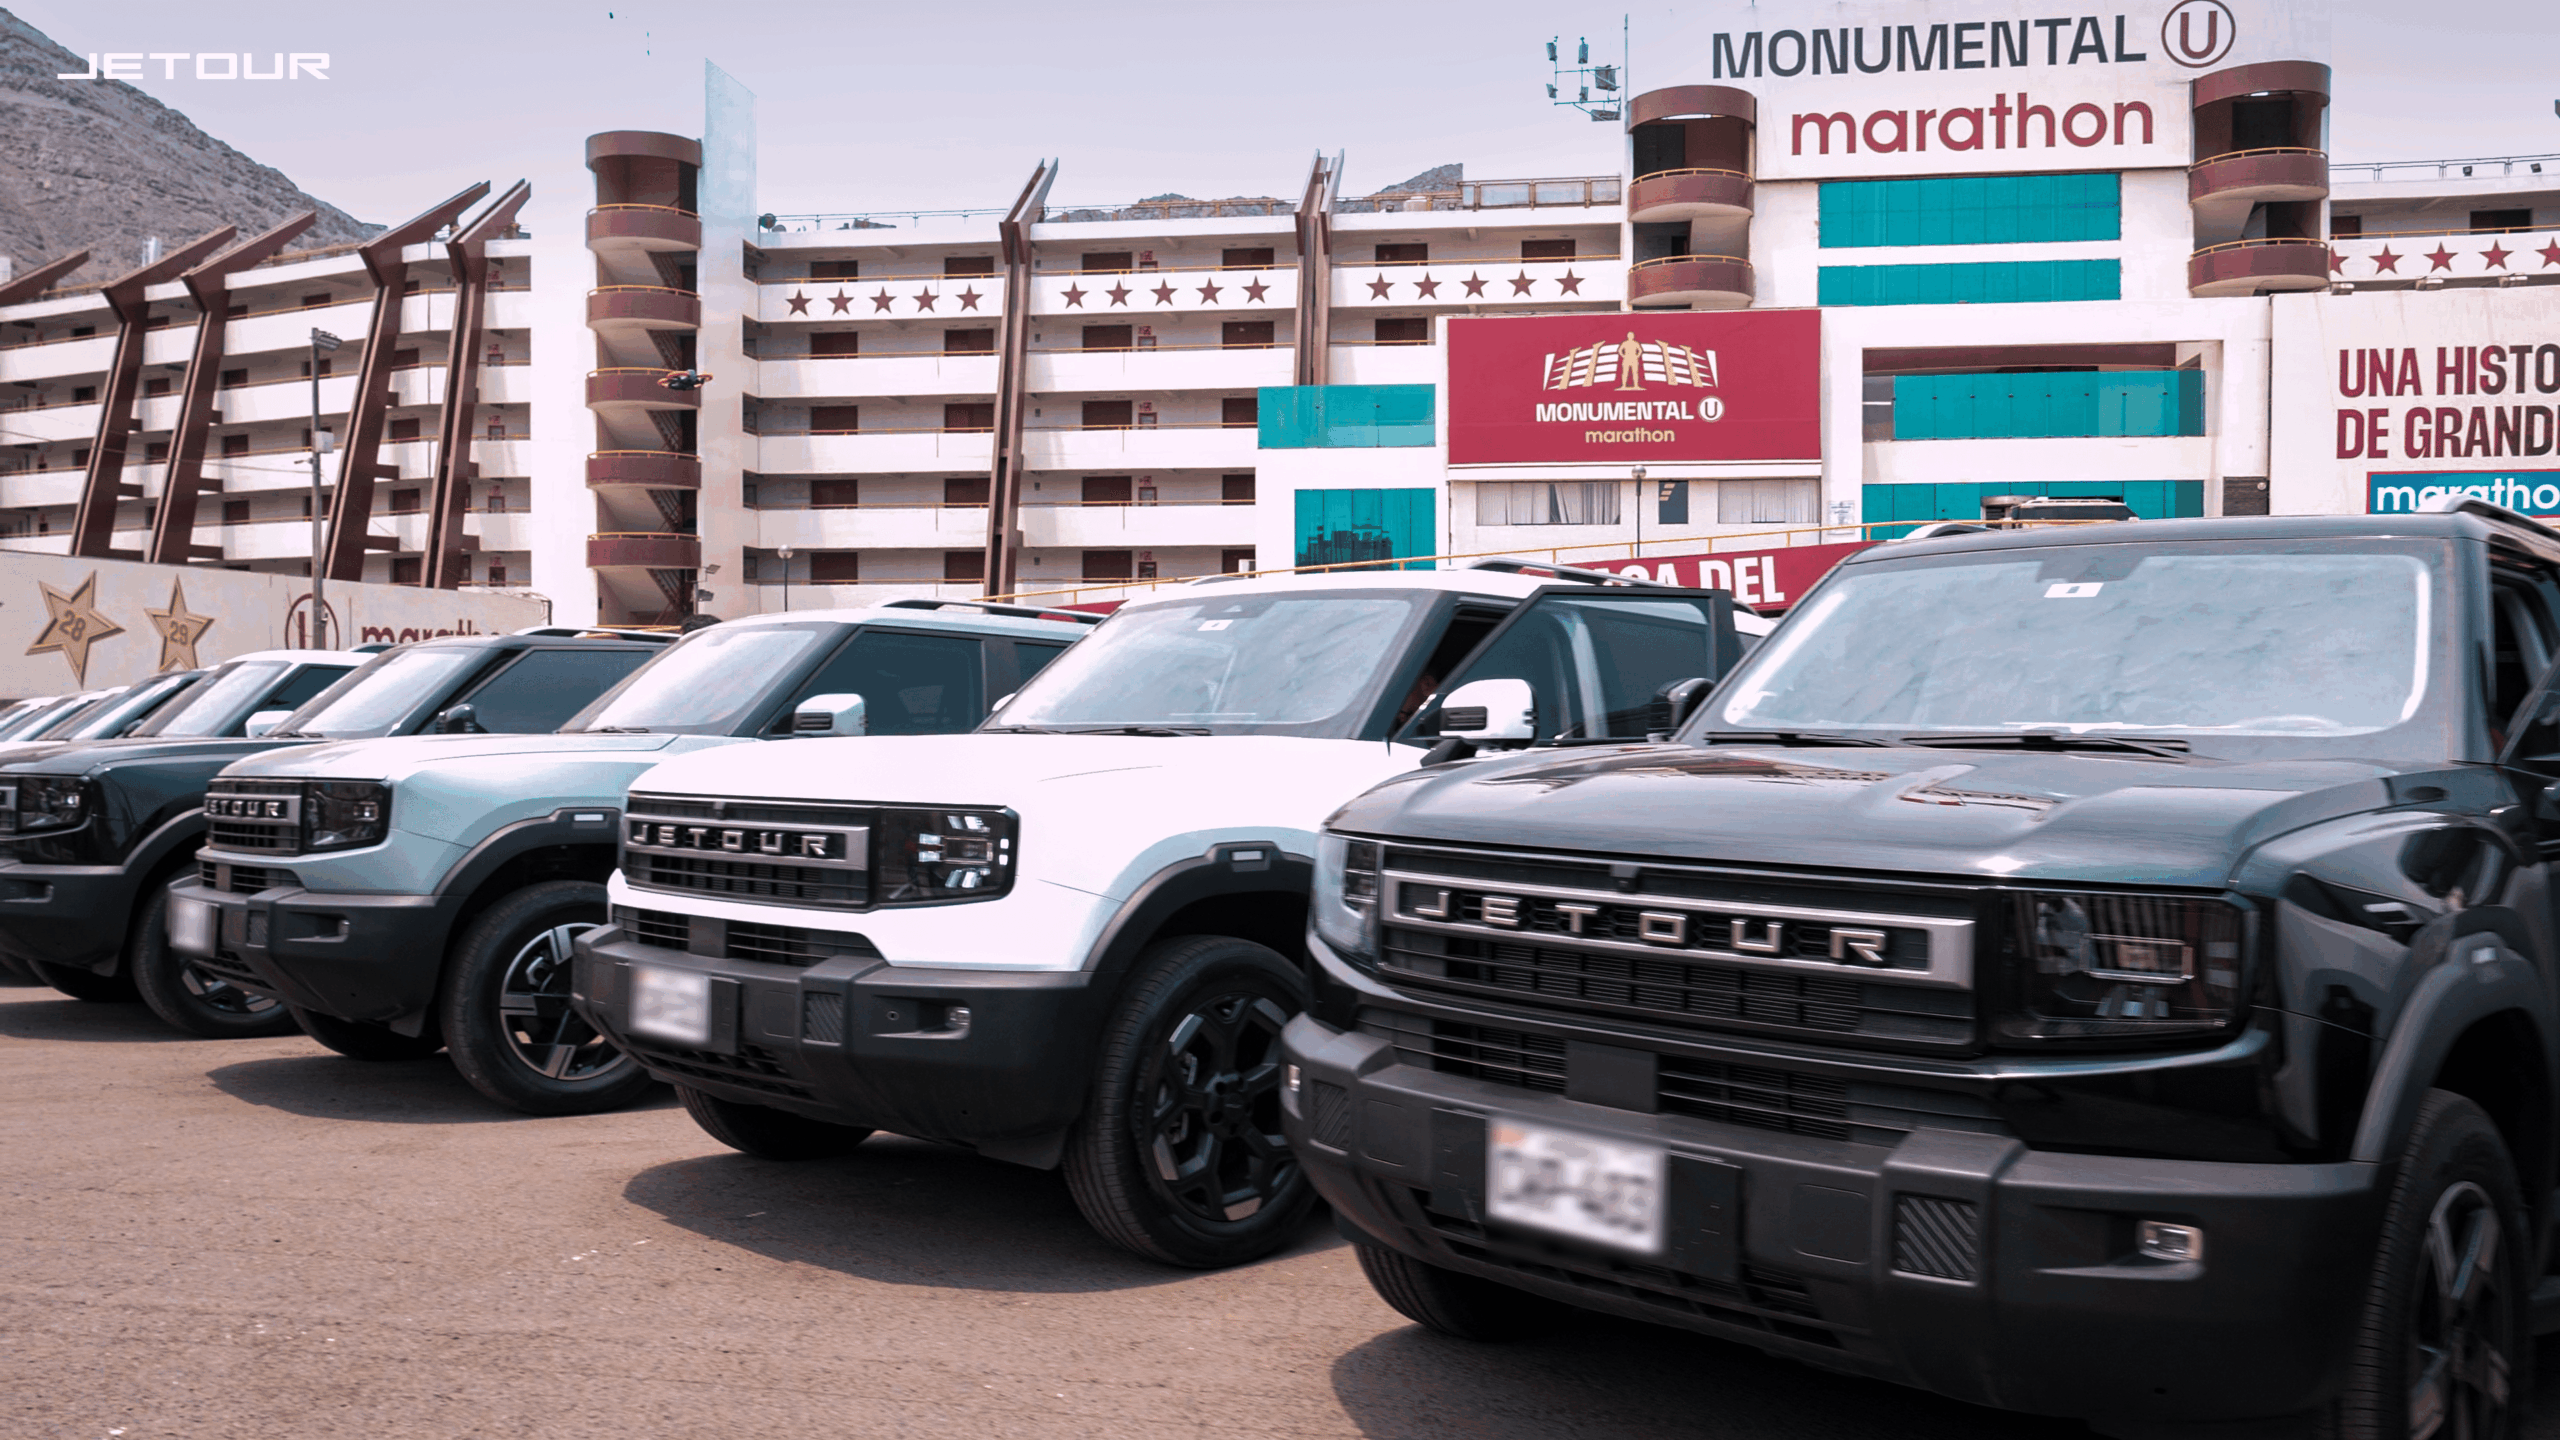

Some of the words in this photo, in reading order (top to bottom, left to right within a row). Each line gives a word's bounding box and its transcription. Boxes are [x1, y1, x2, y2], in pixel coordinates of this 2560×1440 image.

[1712, 15, 2147, 79] MONUMENTAL
[1791, 92, 2153, 156] marathon
[2339, 347, 2422, 398] UNA
[1536, 401, 1694, 422] MONUMENTAL
[1585, 428, 1676, 443] marathon
[2336, 408, 2389, 460] DE
[2403, 405, 2560, 460] GRAND
[1698, 556, 1785, 604] DEL
[59, 610, 87, 642] 28
[168, 621, 189, 646] 29
[632, 823, 828, 856] JETOUR
[1414, 888, 1888, 963] JETOUR
